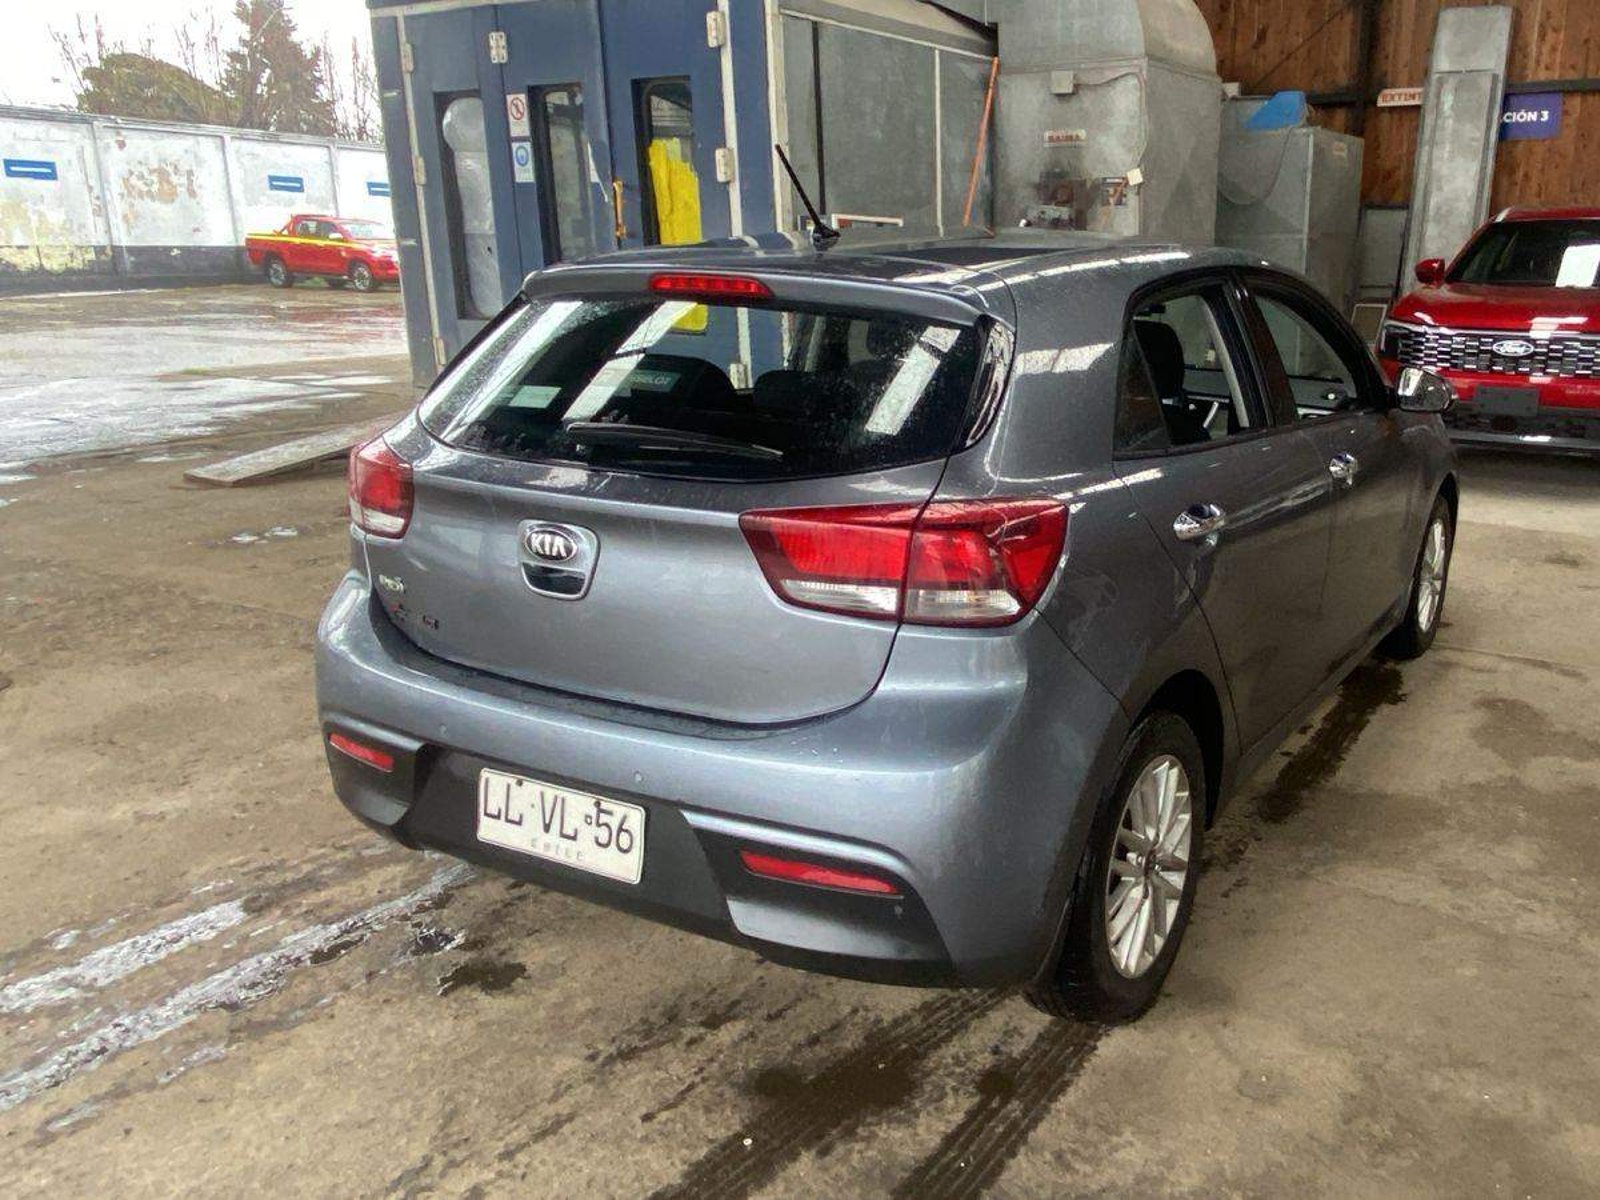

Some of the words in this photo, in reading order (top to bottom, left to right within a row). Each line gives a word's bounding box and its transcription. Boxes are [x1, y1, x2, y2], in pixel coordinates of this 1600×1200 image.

[1501, 109, 1538, 123] CIÓN
[1540, 109, 1550, 121] 3
[531, 532, 567, 558] KIA
